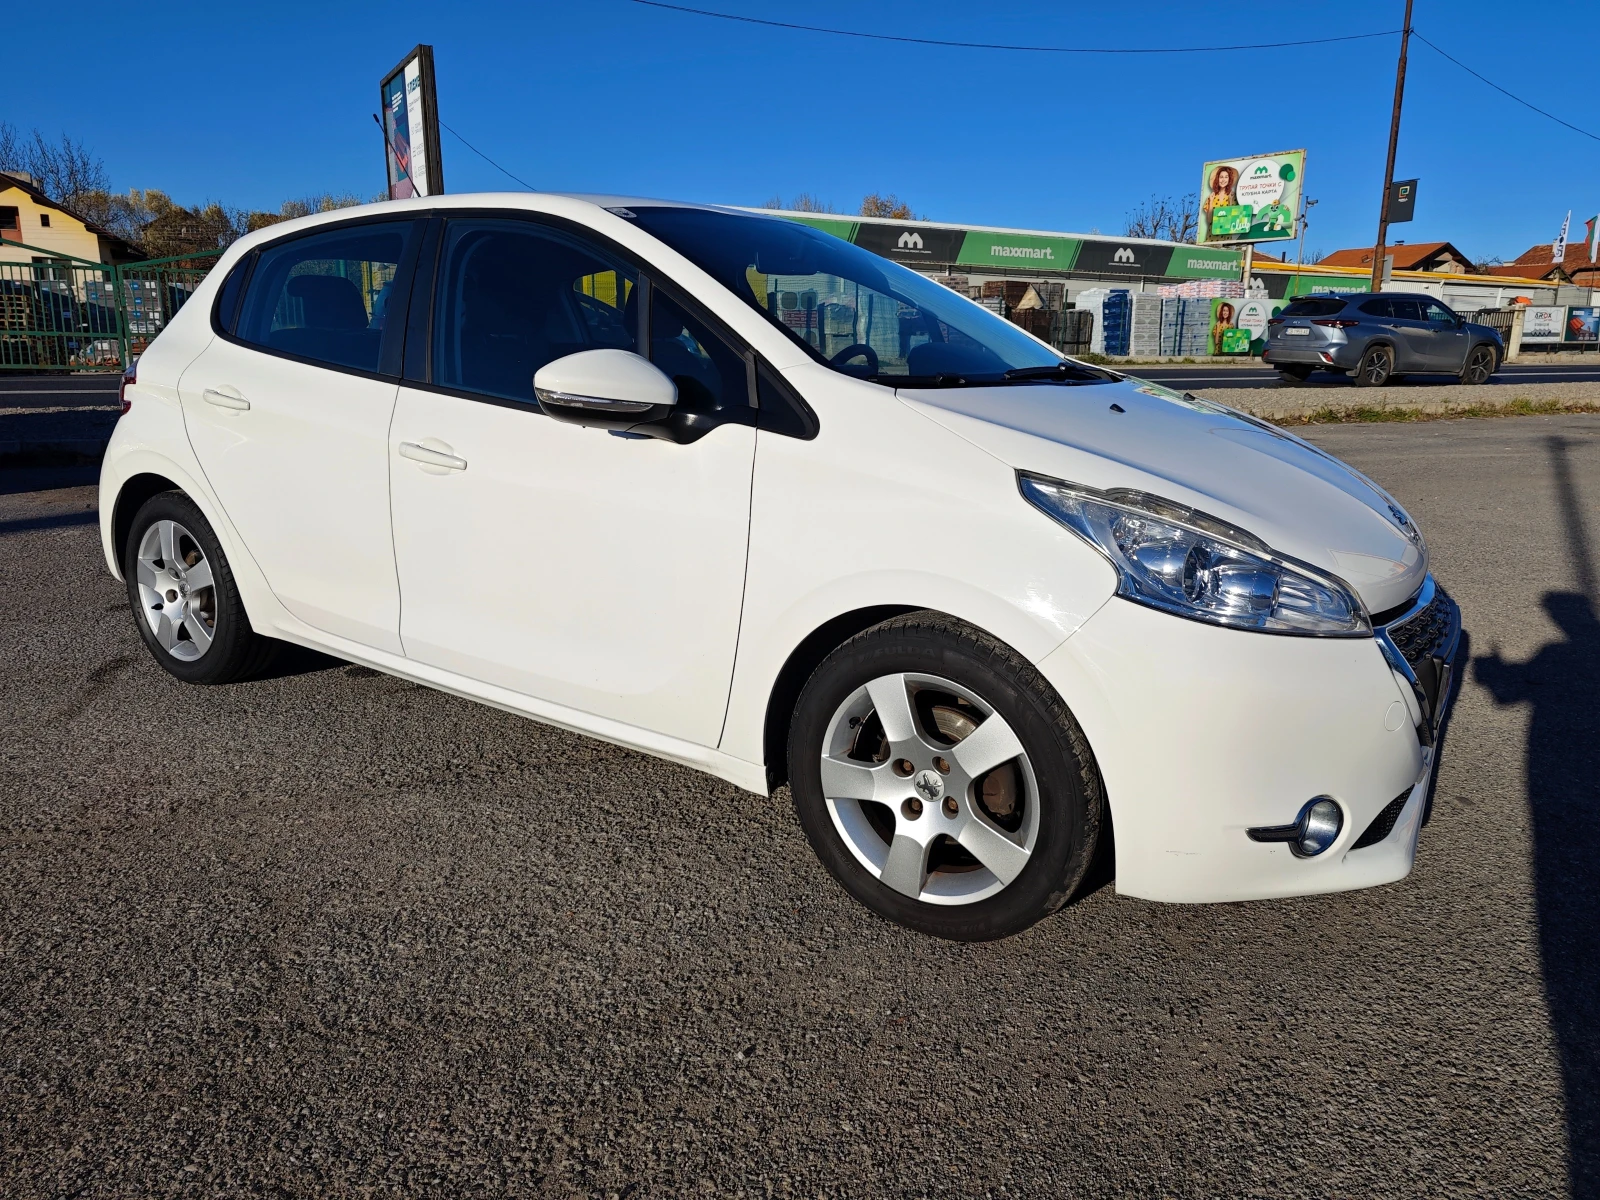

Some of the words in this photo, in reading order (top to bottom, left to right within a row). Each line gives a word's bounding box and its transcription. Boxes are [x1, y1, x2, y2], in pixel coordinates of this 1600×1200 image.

[990, 244, 1055, 260] maxxmart.
[1187, 258, 1239, 272] maxxmart.
[873, 645, 936, 658] FULDA
